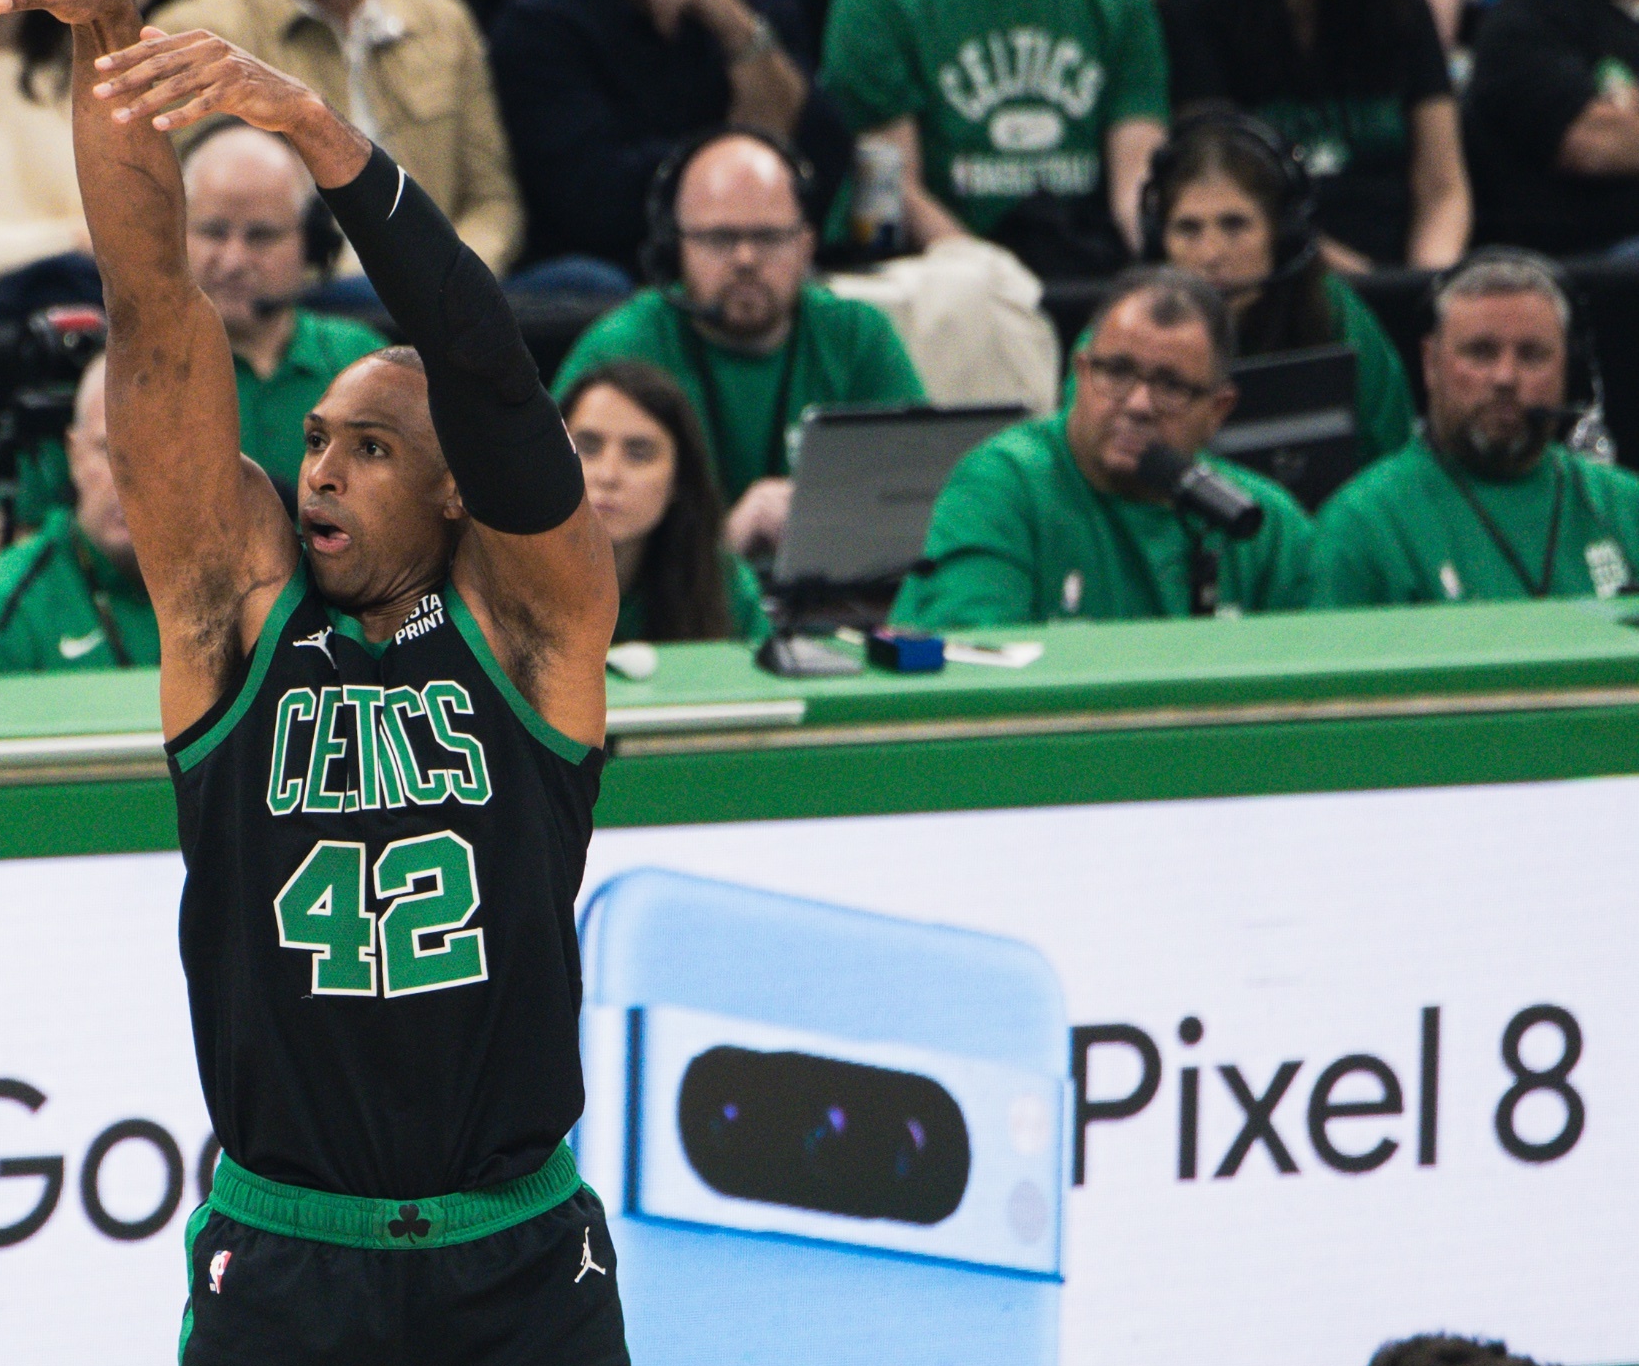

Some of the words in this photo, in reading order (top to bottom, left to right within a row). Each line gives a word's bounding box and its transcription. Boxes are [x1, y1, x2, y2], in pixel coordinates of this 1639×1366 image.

[394, 607, 445, 646] PRINT
[273, 829, 489, 998] 42
[1070, 1005, 1442, 1188] Pixel
[1493, 1003, 1587, 1165] 8
